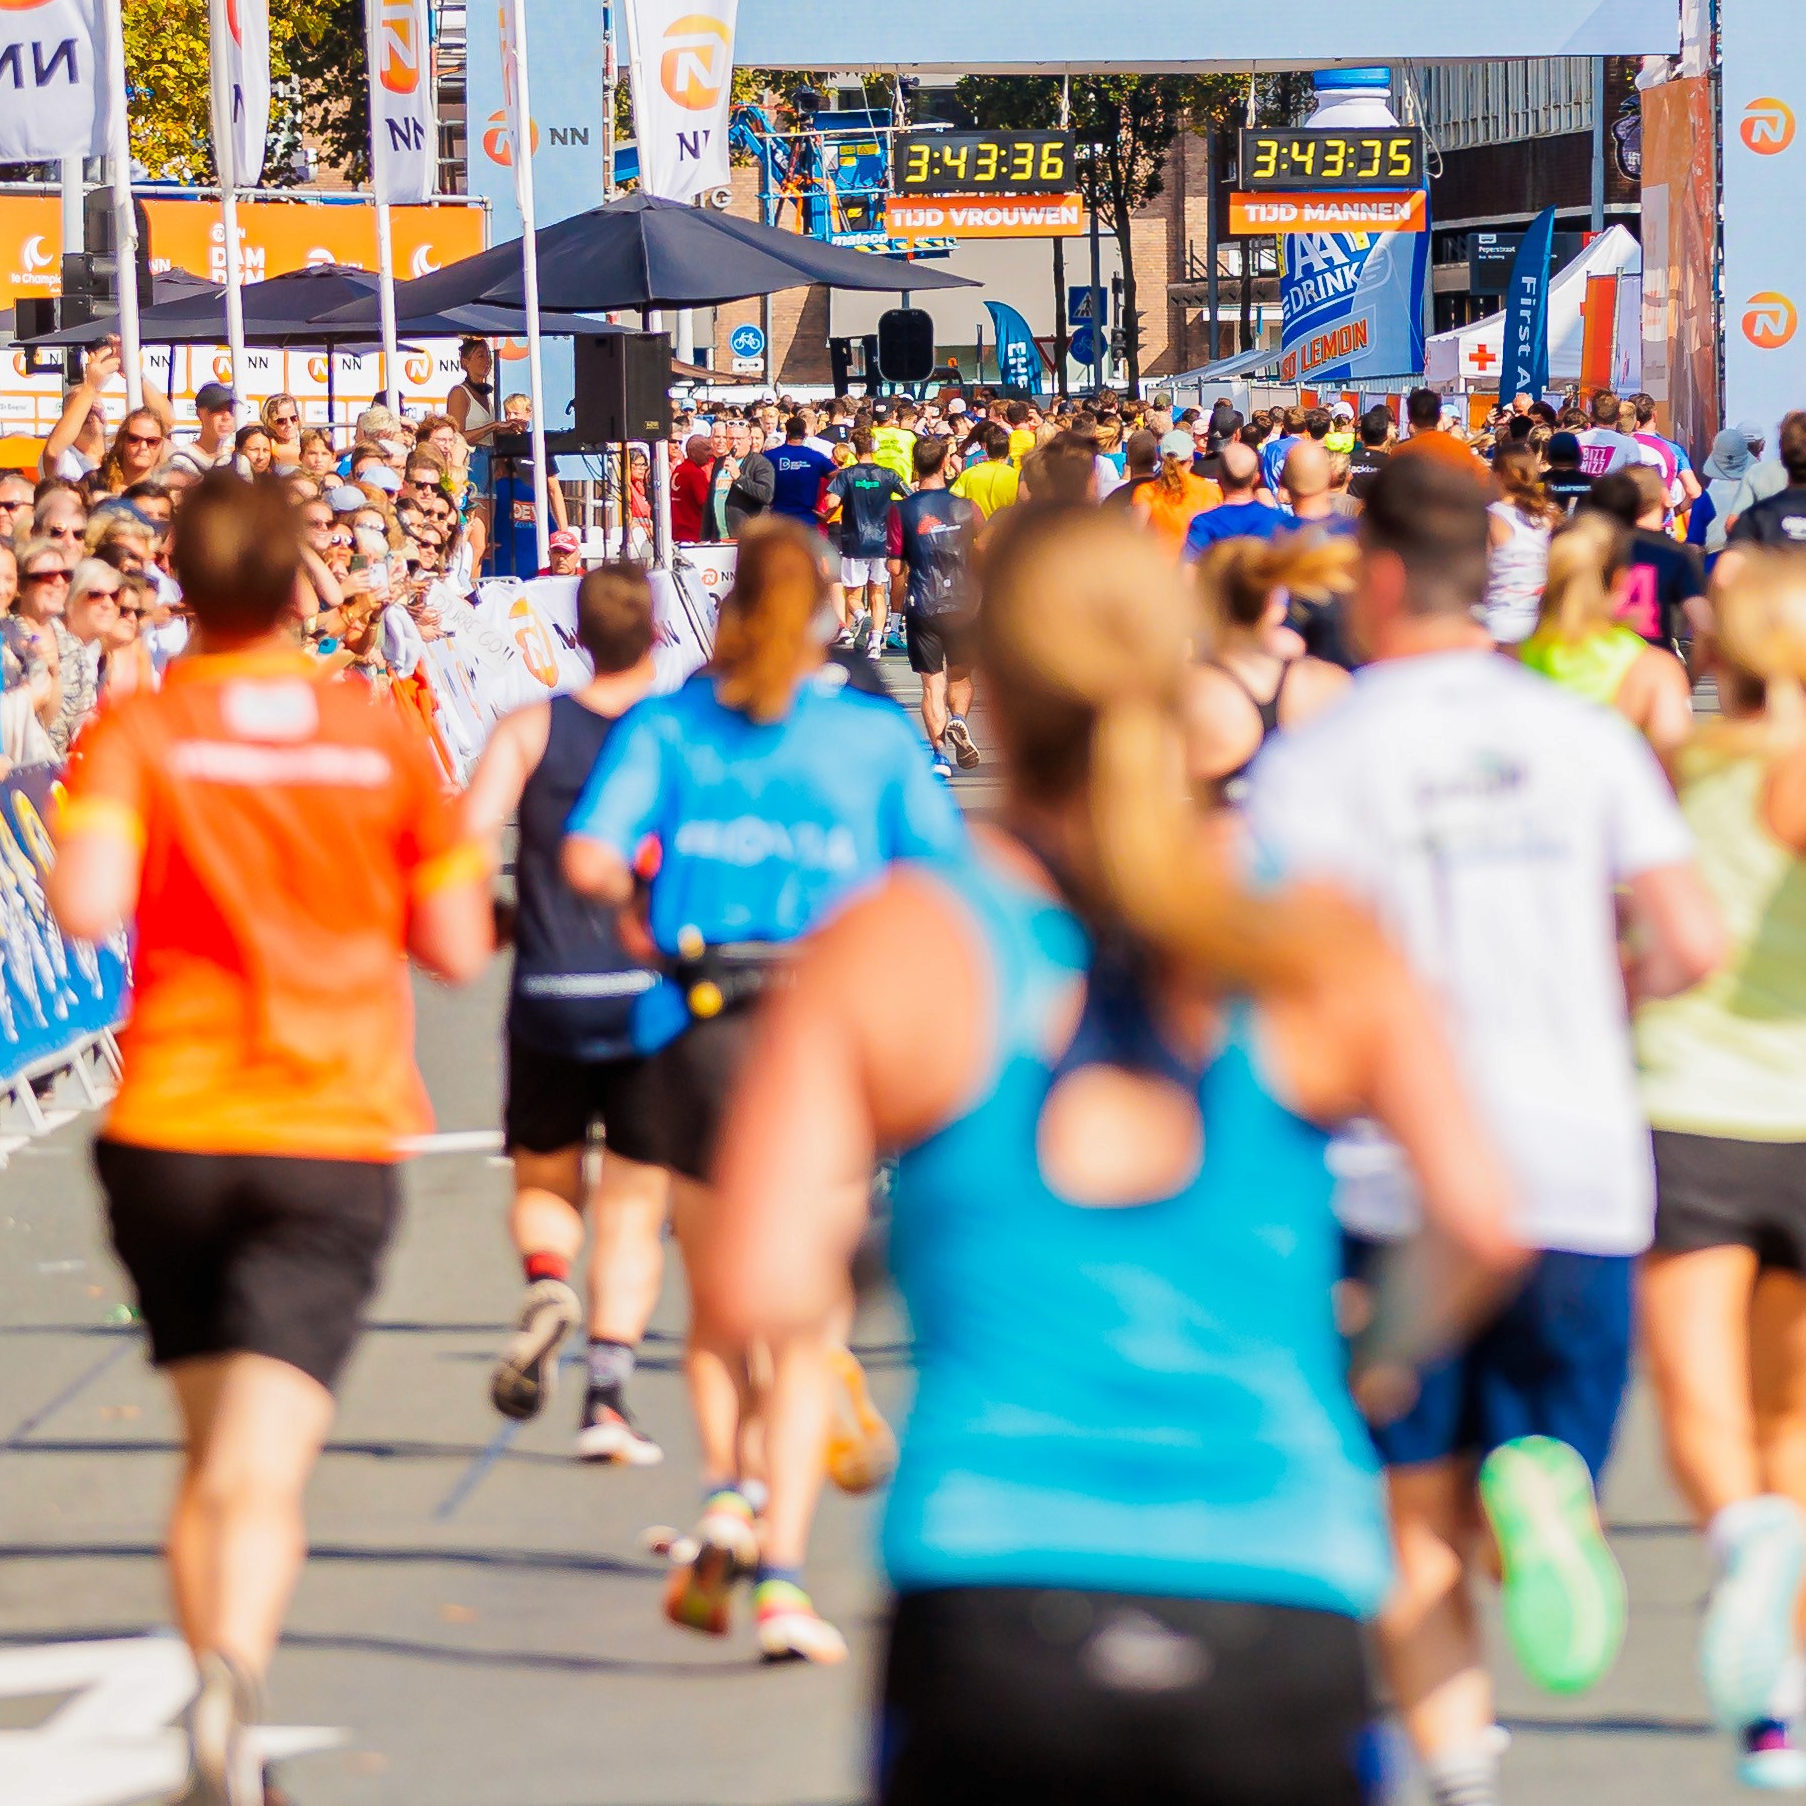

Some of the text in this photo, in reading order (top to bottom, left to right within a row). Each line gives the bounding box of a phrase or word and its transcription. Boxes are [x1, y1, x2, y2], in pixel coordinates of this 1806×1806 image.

[549, 127, 590, 146] NN
[905, 141, 1065, 184] 3:43:36
[890, 204, 1079, 228] TIJD VROUWEN
[1245, 202, 1412, 225] TIJD MANNEN
[831, 233, 889, 246] mateco
[1289, 260, 1364, 315] DRINK
[1518, 276, 1537, 358] First
[1300, 317, 1370, 375] LEMON
[247, 355, 269, 369] NN
[341, 358, 363, 371] NN
[439, 359, 462, 372] NN
